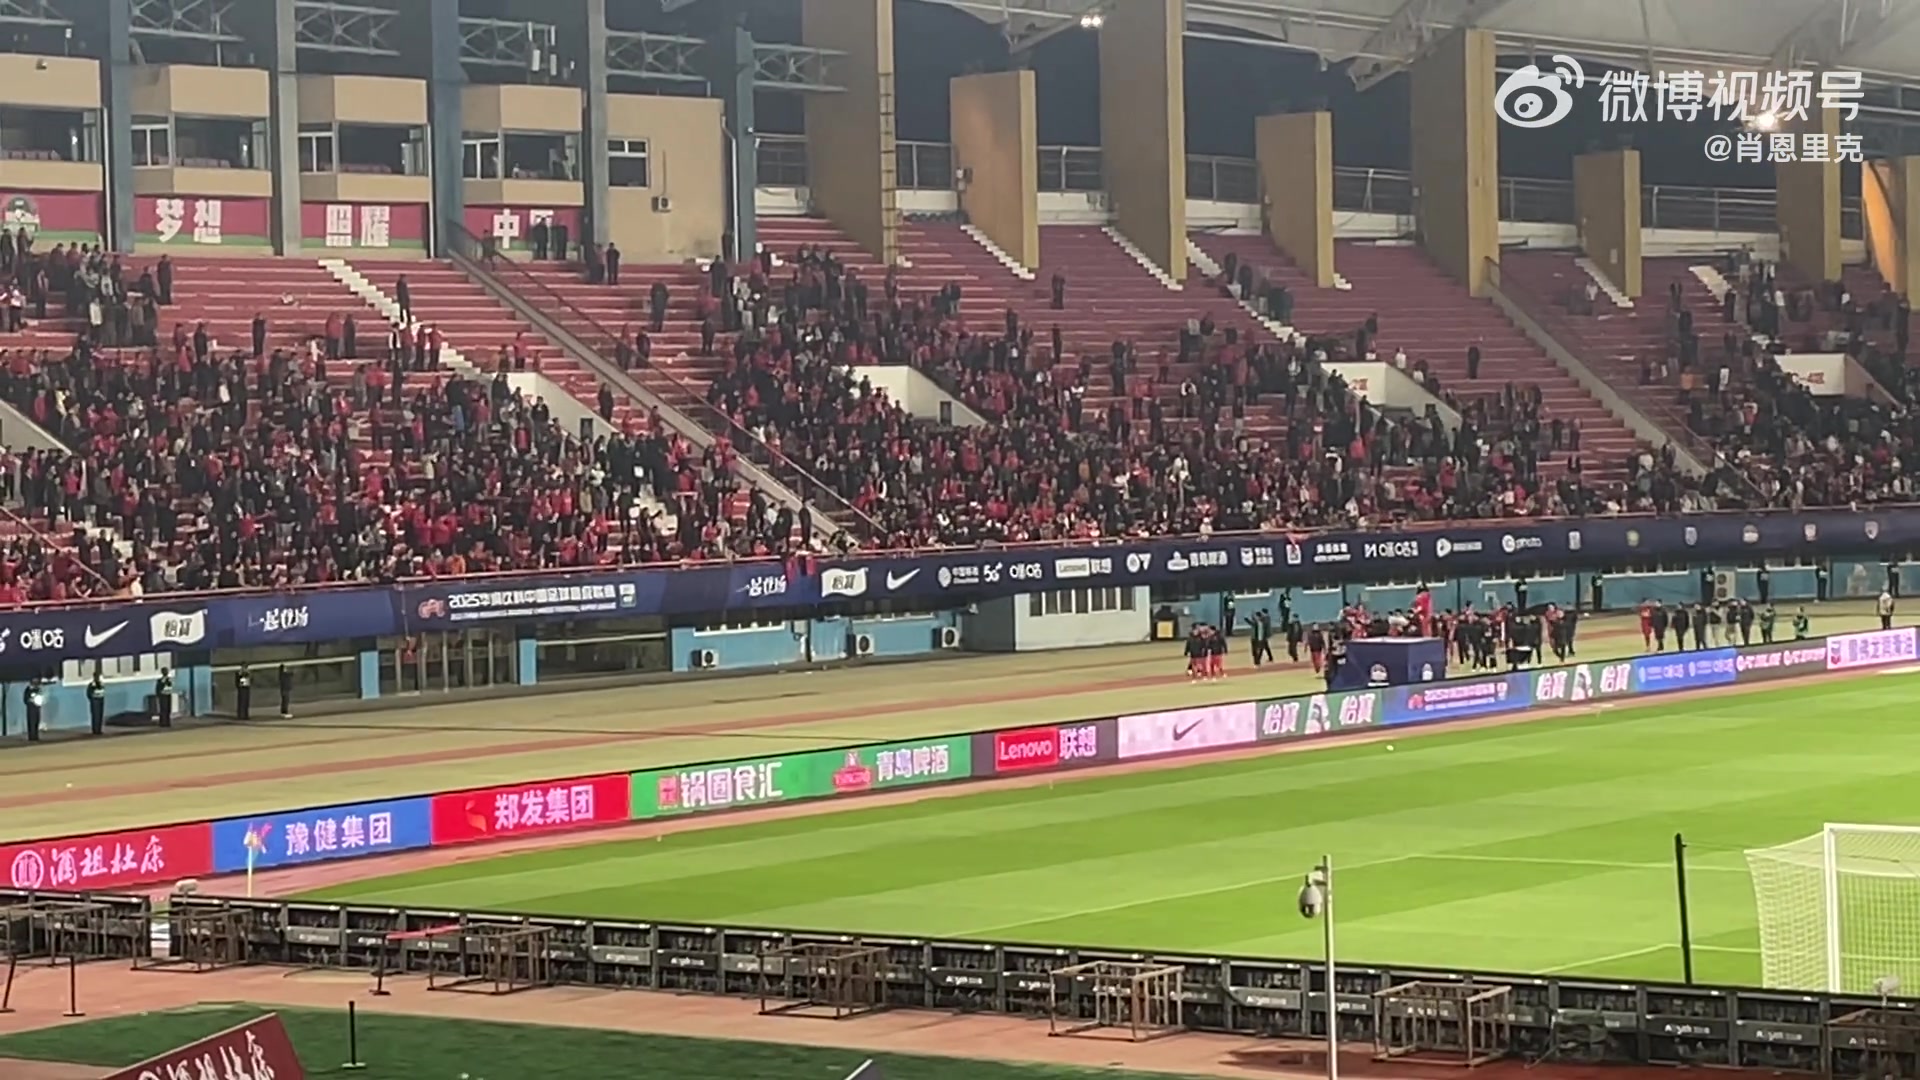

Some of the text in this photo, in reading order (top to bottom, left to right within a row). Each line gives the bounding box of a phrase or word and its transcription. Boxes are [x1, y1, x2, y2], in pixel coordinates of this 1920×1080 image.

[156, 198, 222, 244] 梦想
[876, 744, 949, 783] 青岛啤酒
[999, 725, 1097, 762] Lenovo 联想
[494, 784, 594, 831] 郑发集团
[680, 761, 783, 808] 锅圈食汇
[286, 811, 393, 857] 豫健集团
[48, 835, 166, 887] 酒祖杜康
